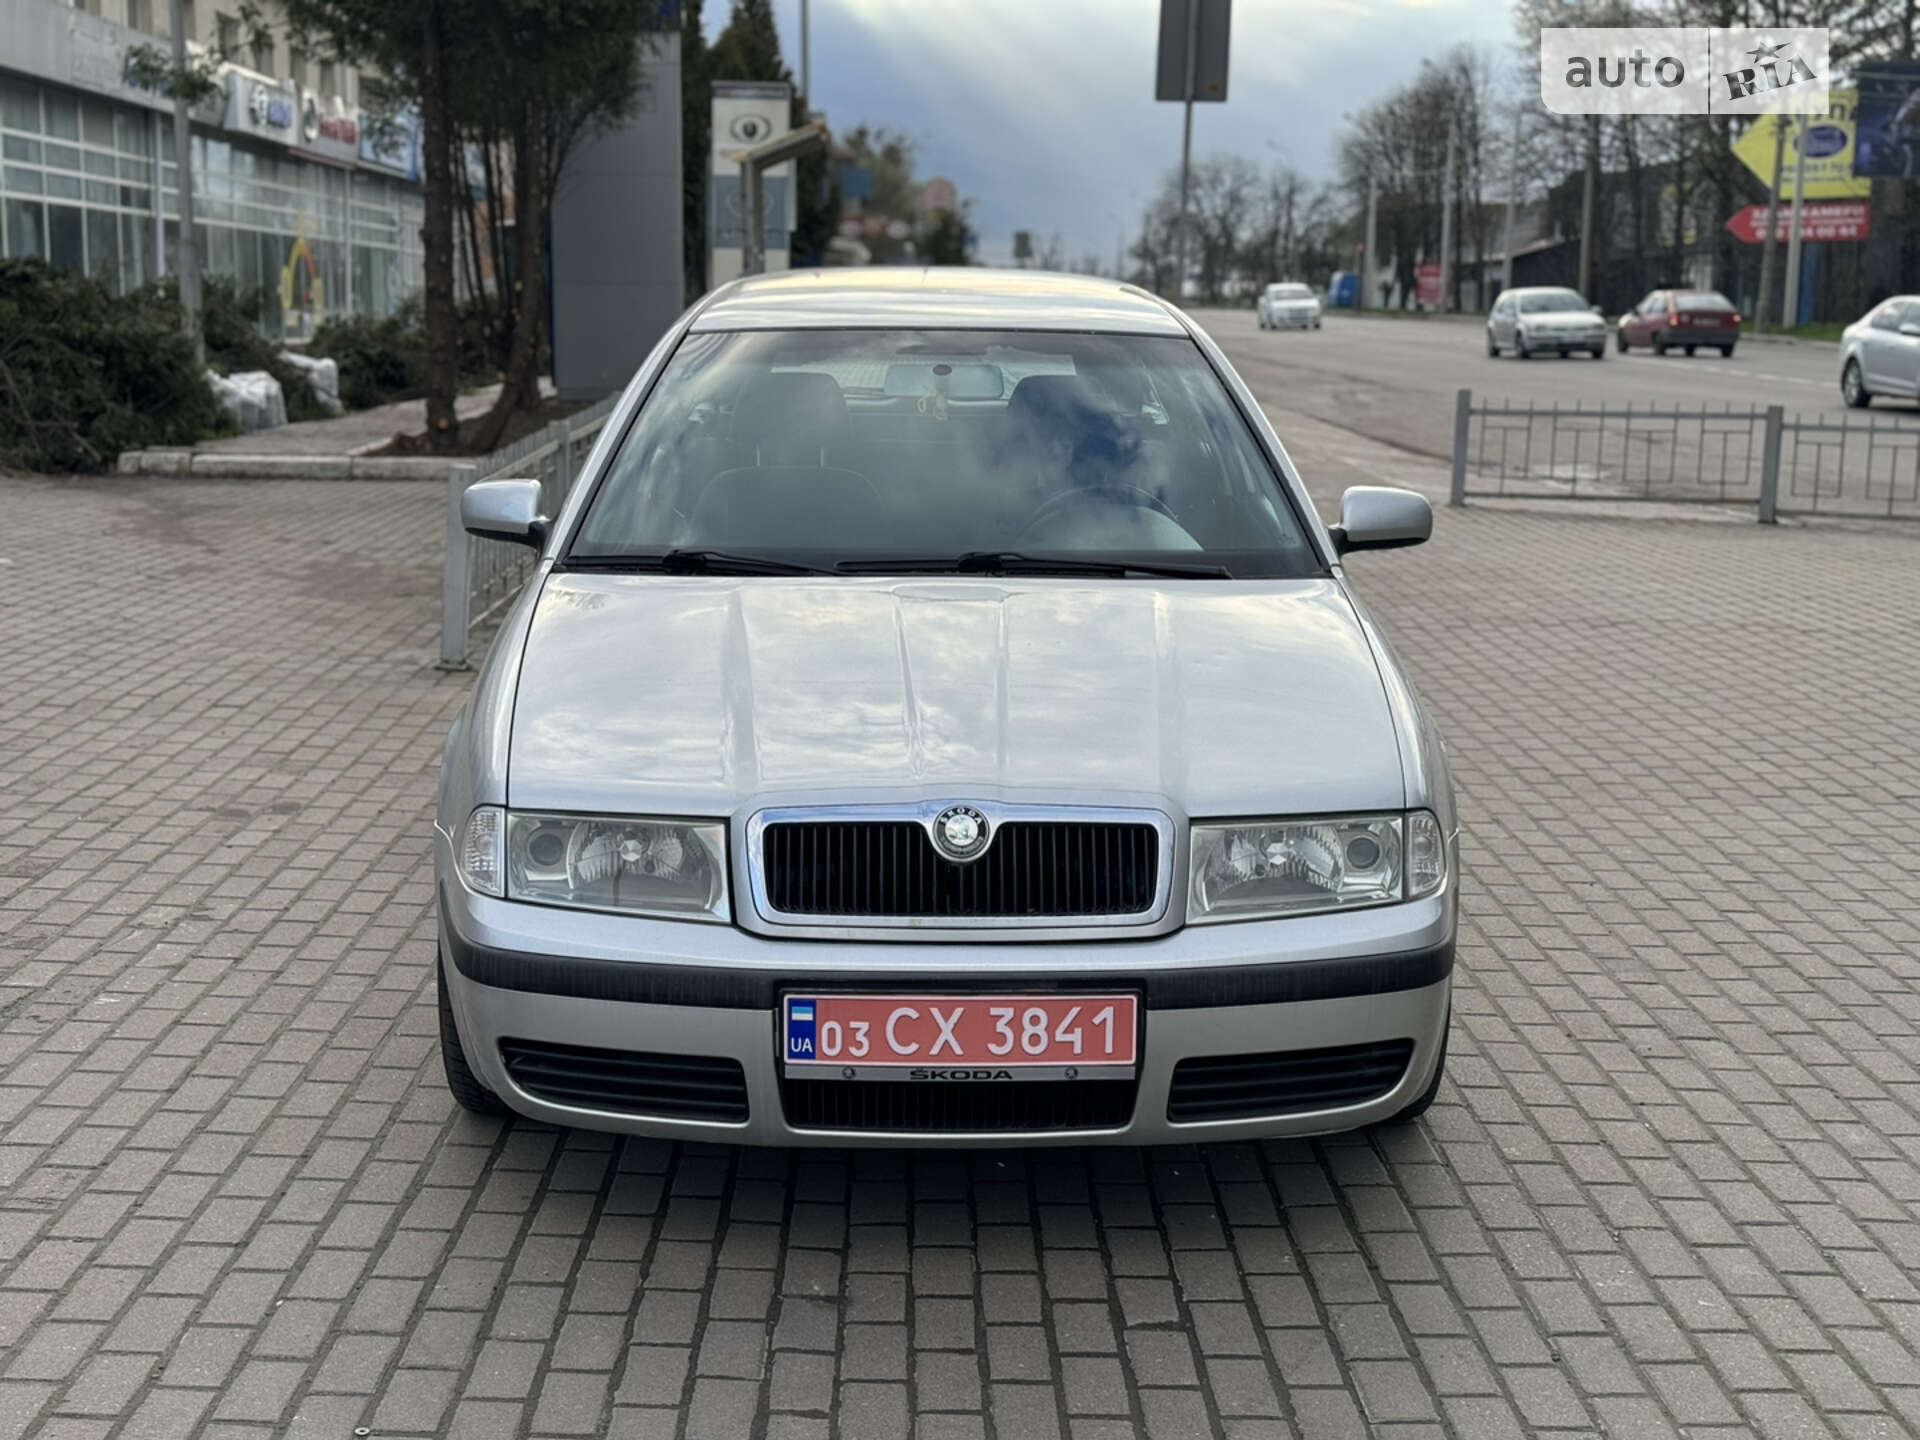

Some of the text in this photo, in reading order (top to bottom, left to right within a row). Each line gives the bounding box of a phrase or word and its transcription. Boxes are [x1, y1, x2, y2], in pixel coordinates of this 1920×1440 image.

[791, 1037, 813, 1053] UA
[821, 1006, 1115, 1057] 03 CX 3841
